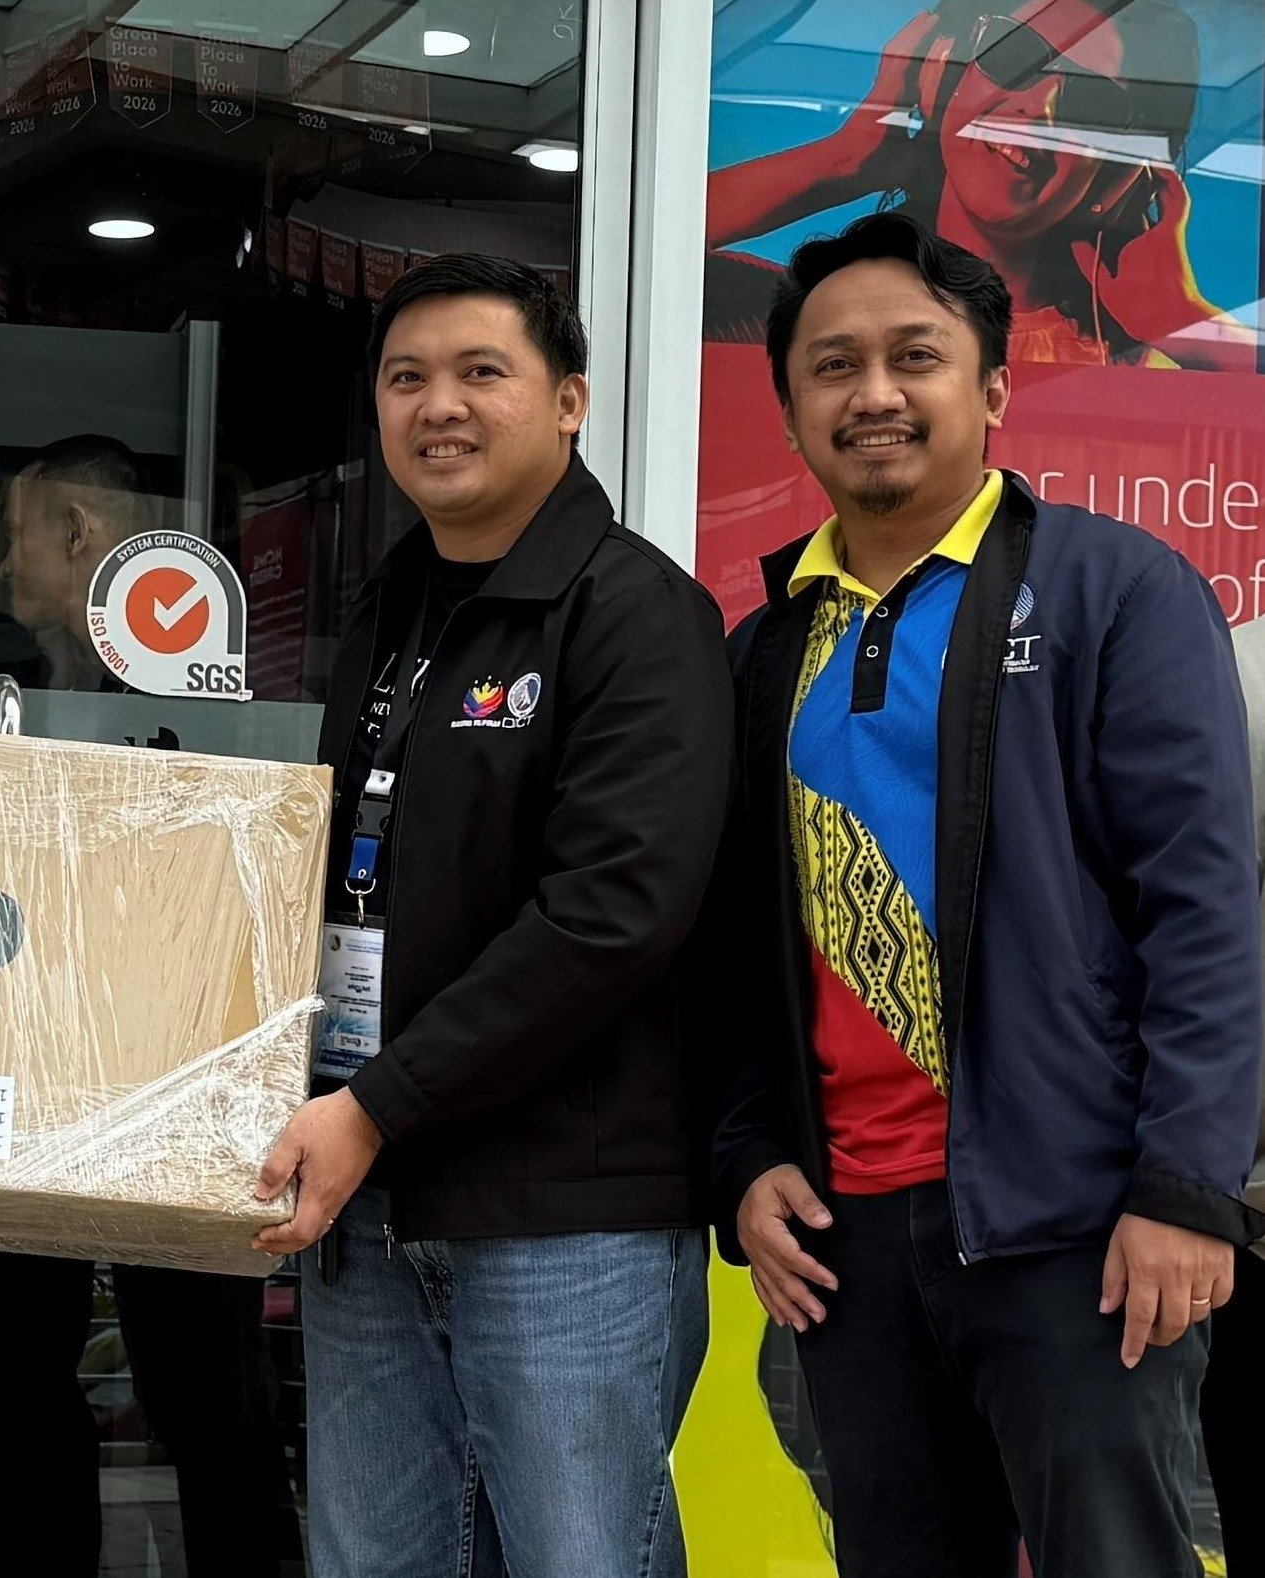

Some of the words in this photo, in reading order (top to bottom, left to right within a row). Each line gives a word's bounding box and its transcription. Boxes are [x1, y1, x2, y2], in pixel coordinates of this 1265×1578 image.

[114, 73, 153, 88] Work
[52, 96, 81, 115] 2026
[123, 95, 156, 111] 2026
[211, 100, 241, 117] 2026
[116, 536, 153, 562] SYSTEM
[154, 535, 221, 568] CERTIFICATION
[90, 612, 107, 637] ISO
[99, 640, 130, 675] 45001
[187, 662, 242, 693] SGS
